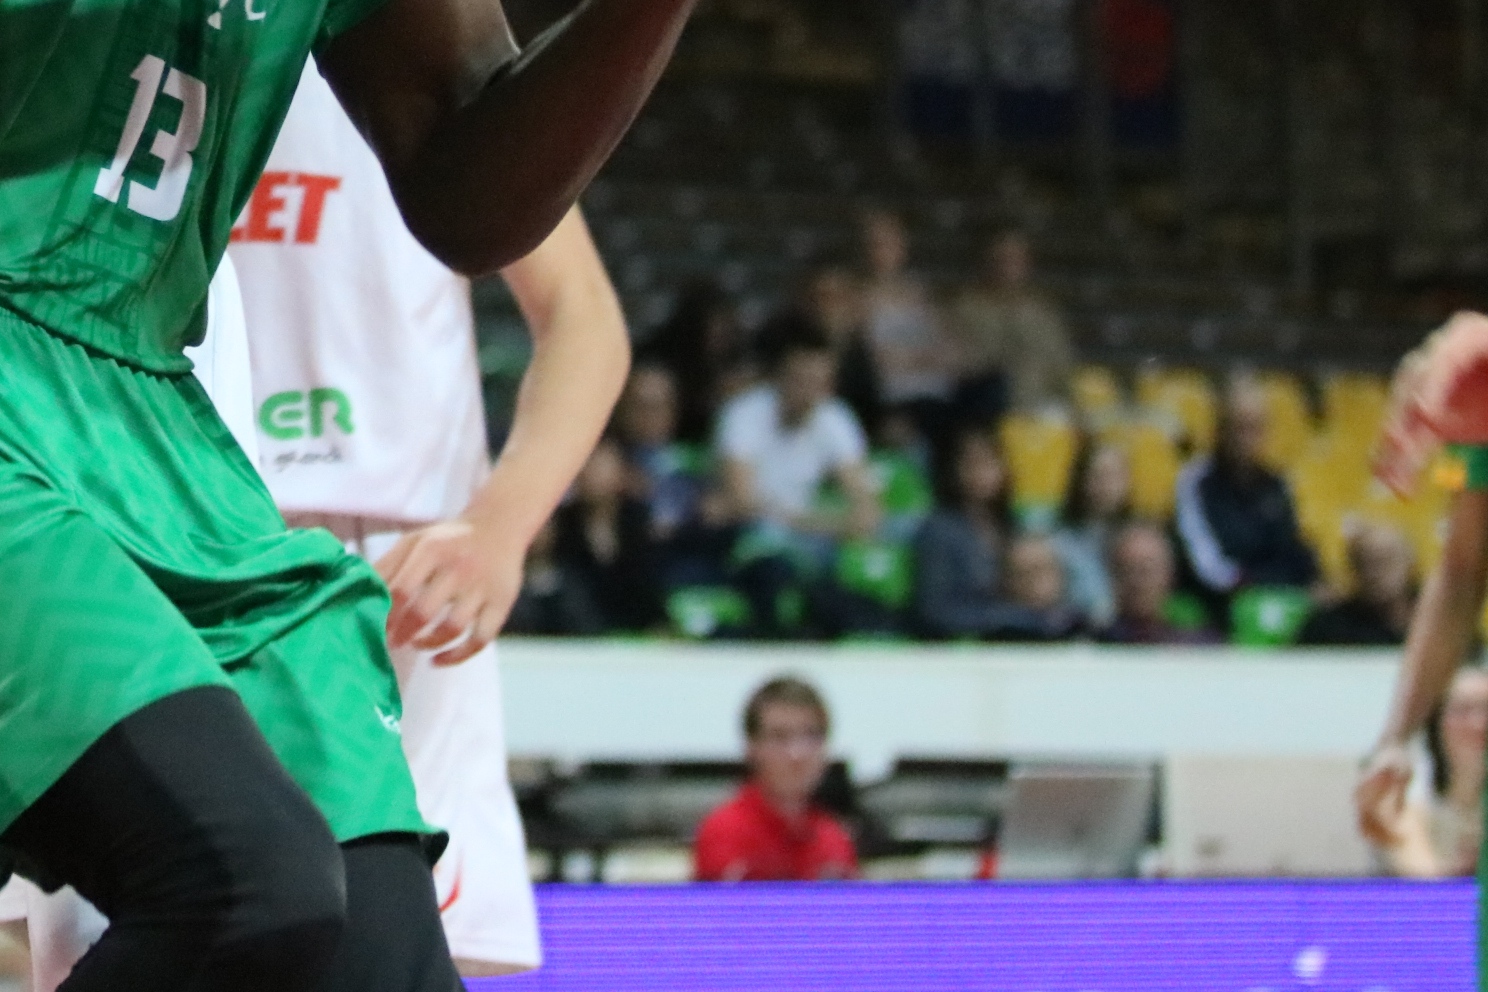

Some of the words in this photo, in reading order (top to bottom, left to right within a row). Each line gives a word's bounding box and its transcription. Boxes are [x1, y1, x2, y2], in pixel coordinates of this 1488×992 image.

[93, 53, 207, 221] 13
[228, 171, 342, 245] ET
[258, 387, 355, 440] ER
